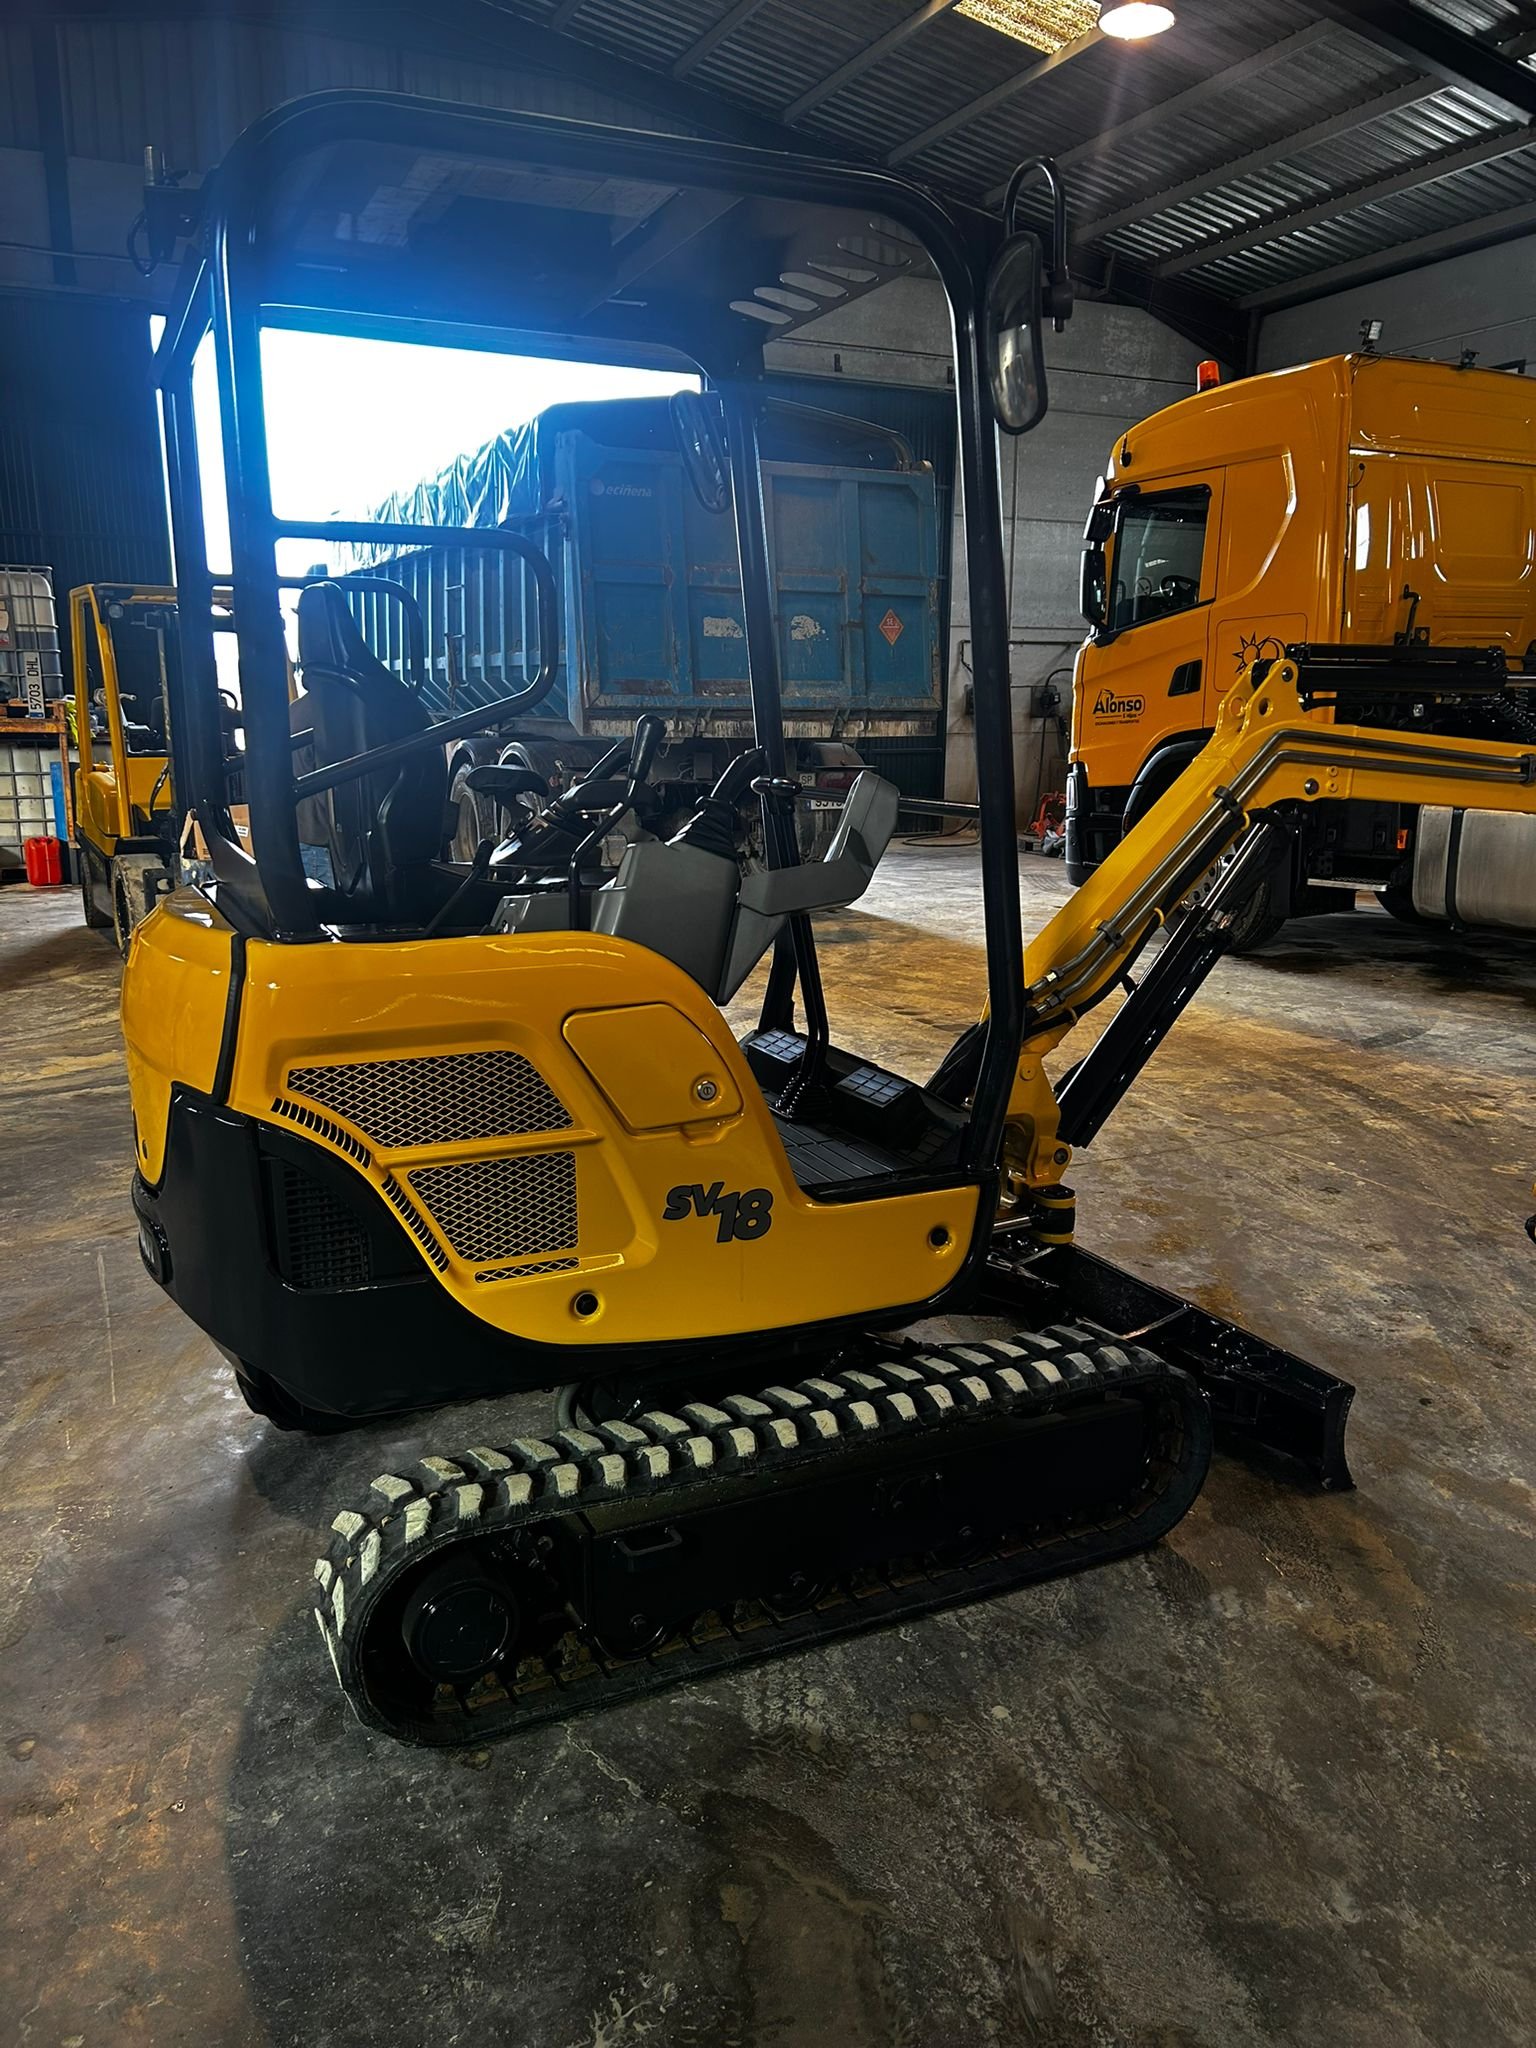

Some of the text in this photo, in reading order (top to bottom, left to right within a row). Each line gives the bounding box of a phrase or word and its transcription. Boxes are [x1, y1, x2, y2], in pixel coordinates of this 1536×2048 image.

[26, 657, 42, 710] 5703 DHL
[1092, 697, 1142, 715] Alonso
